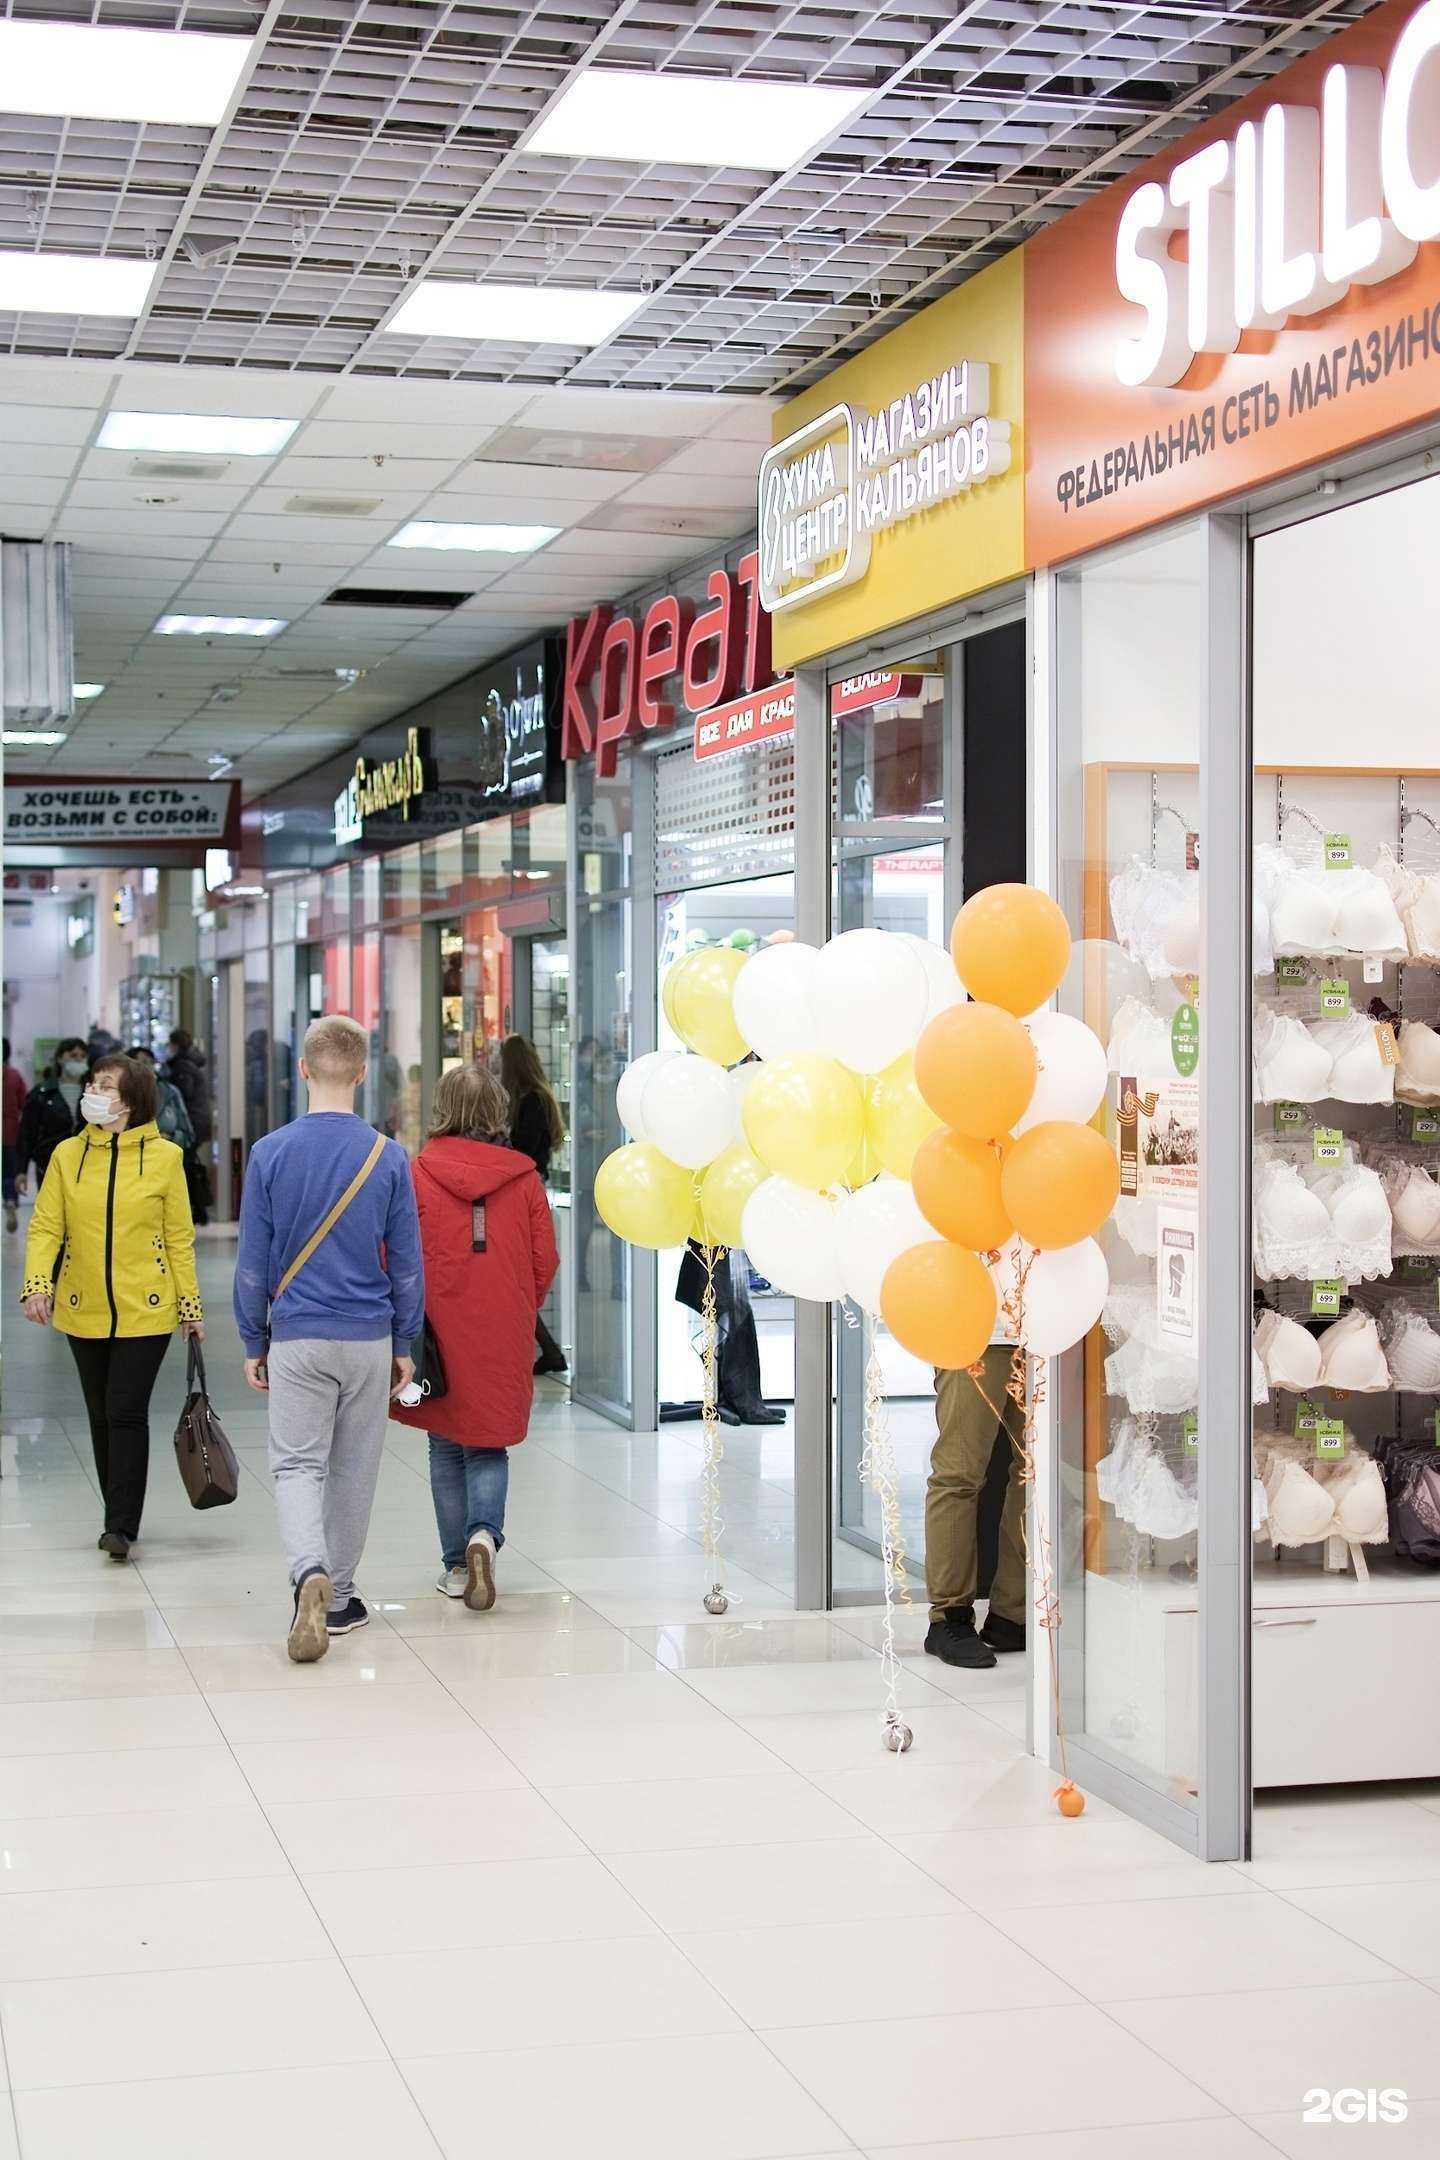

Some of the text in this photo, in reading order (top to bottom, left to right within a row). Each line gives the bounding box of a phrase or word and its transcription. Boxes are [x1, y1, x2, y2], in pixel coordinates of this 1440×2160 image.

[856, 359, 969, 472] МАГАЗИН
[1056, 405, 1216, 513] ФЕДЕРАЛЬНАЯ
[1221, 382, 1280, 444] СЕТЬ
[781, 441, 837, 514] ХУКА
[856, 416, 991, 533] КАЛЬЯНОВ
[780, 492, 847, 577] ЦЕНТР
[699, 720, 721, 746] ВСЕ
[726, 709, 753, 739] ДЛЯ
[760, 694, 795, 726] КРАС
[23, 791, 121, 807] ХОЧЕШЬ
[128, 790, 184, 805] ЕСТЬ
[7, 805, 218, 828] ВОЗЬМИ С СОБОЙ:
[885, 859, 943, 872] THERAP
[1331, 851, 1345, 859] 899
[1327, 998, 1342, 1006] 899
[1321, 1148, 1336, 1156] 999
[1323, 1439, 1338, 1447] 899
